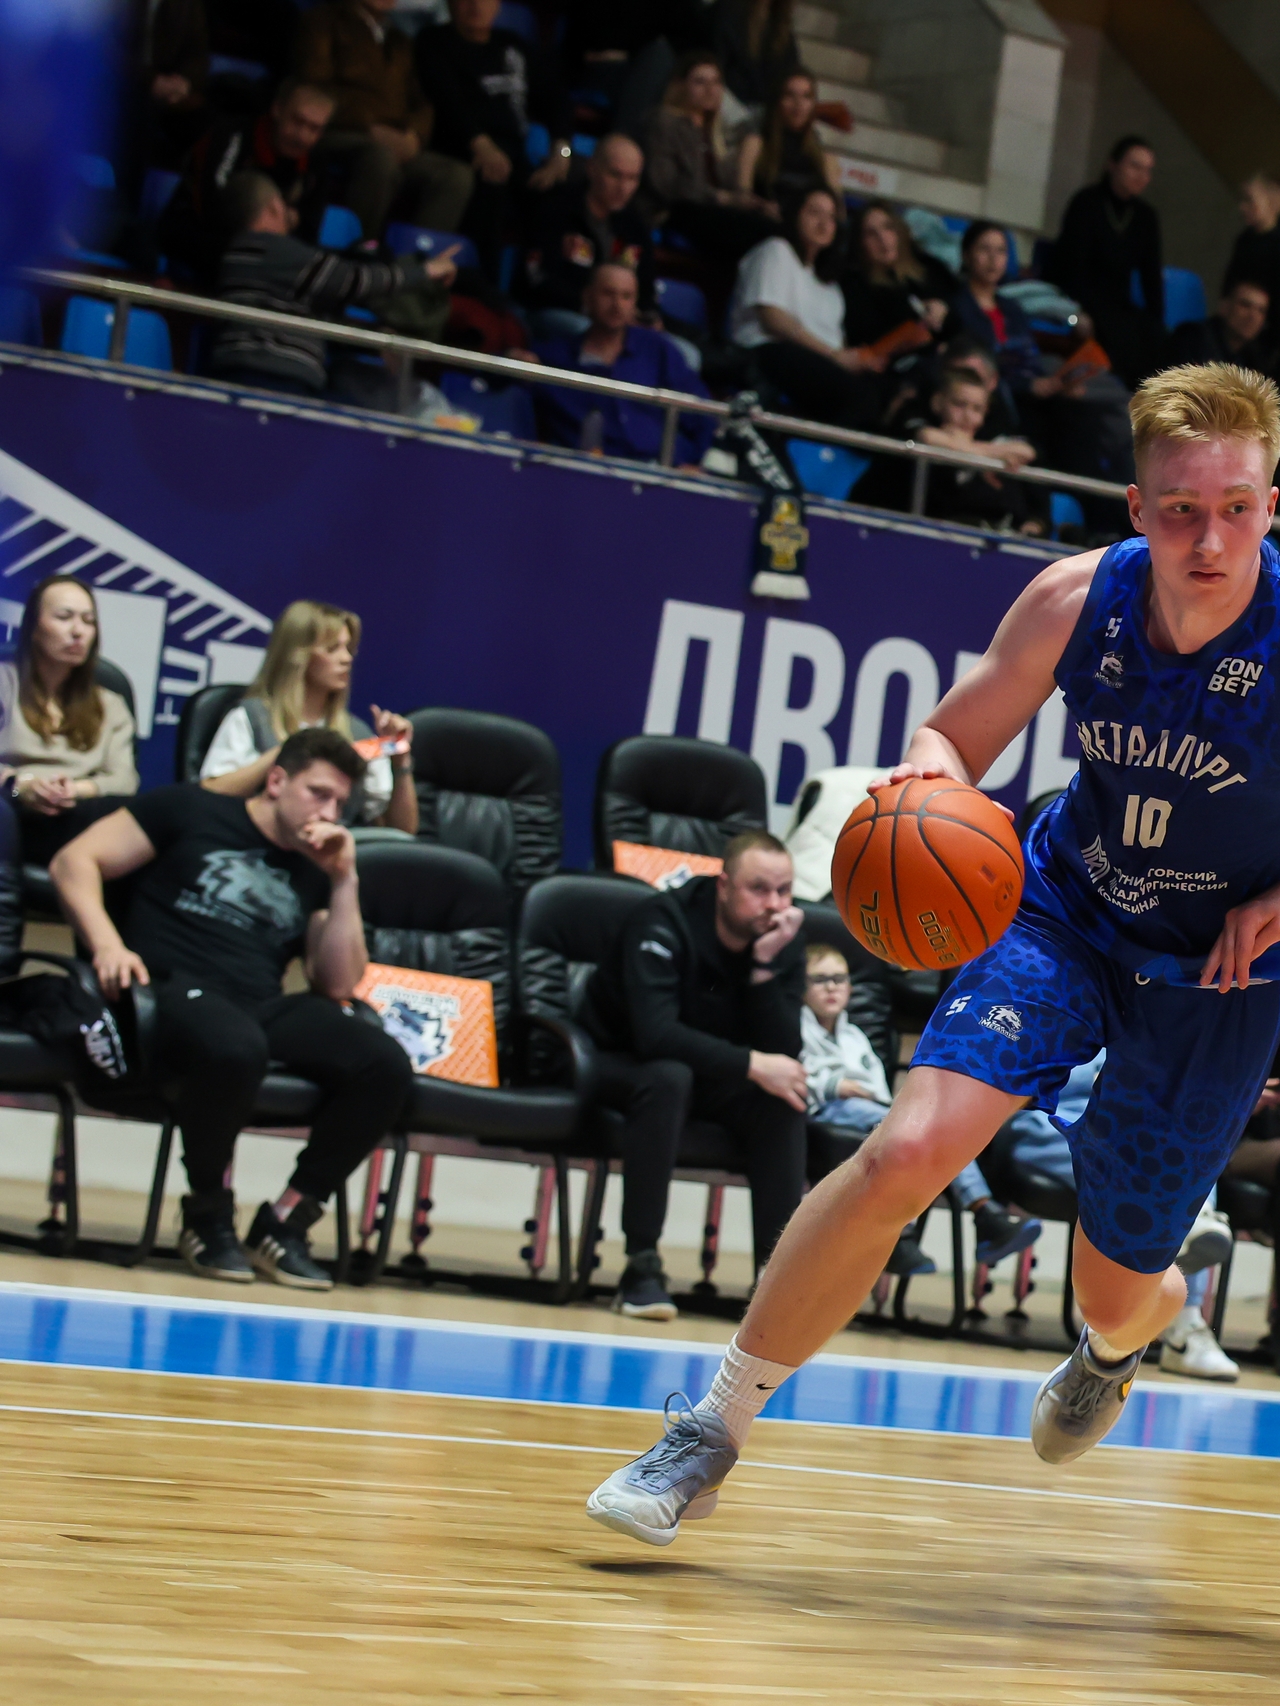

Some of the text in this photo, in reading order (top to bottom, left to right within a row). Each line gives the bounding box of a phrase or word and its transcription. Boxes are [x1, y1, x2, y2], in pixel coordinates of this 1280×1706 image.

[1215, 657, 1264, 681] FON
[1207, 674, 1256, 697] BET
[1122, 794, 1173, 849] 10
[1097, 885, 1160, 915] КОМБИНАТ
